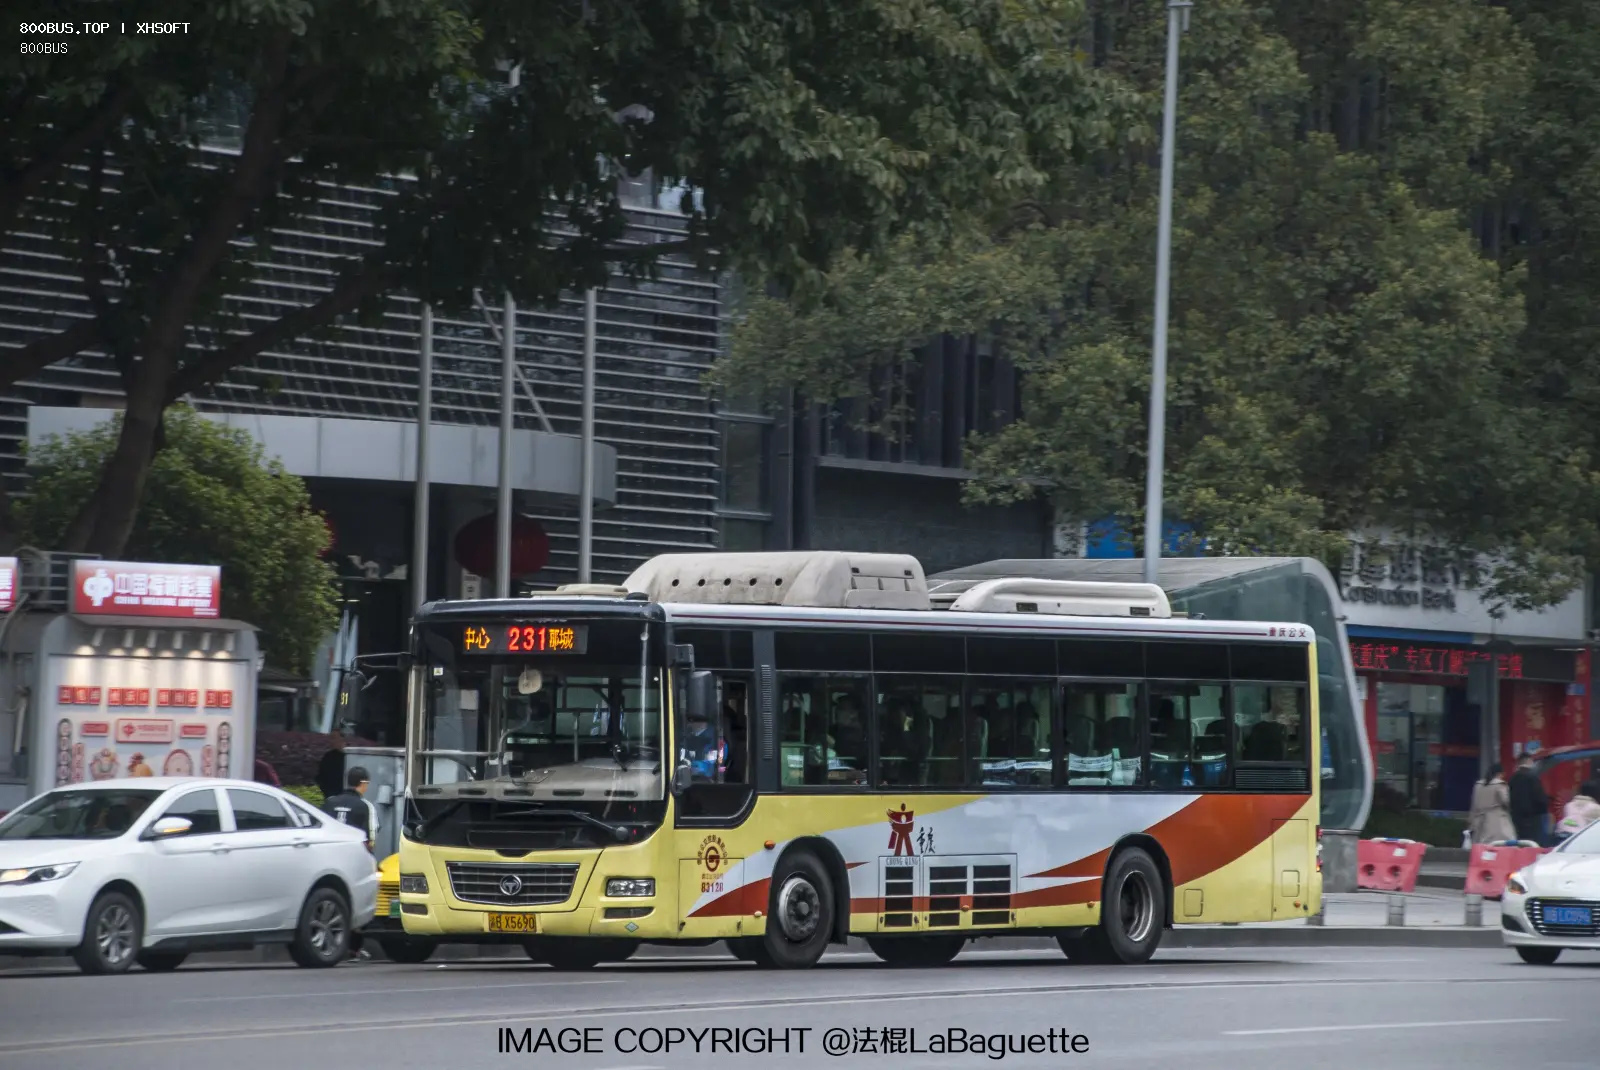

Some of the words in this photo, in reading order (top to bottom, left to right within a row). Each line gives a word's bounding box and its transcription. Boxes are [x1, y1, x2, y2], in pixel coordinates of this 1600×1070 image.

[508, 625, 547, 651] 231
[1268, 626, 1307, 638] 重庆公交
